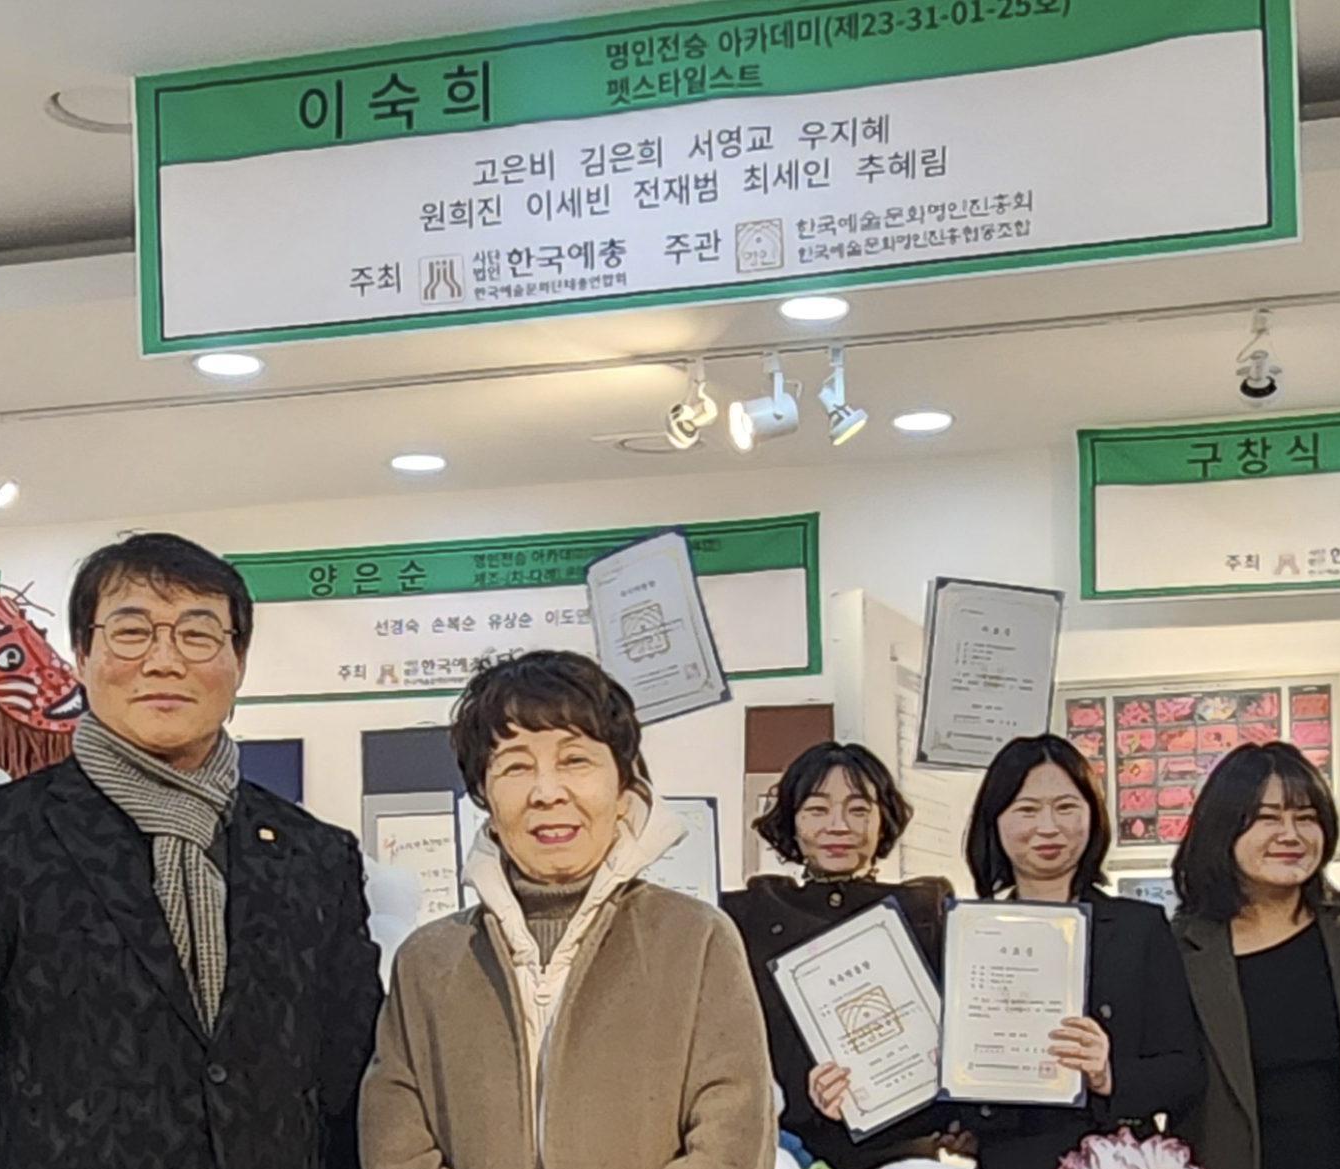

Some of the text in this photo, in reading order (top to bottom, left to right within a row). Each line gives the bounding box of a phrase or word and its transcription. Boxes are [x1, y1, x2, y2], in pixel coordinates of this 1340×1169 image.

[606, 33, 708, 71] 명인전승
[299, 60, 490, 139] 이숙희
[606, 64, 763, 107] 펫스타일스트
[472, 114, 890, 186] 고은비 김은희 서영교 우지혜
[420, 145, 948, 232] 원희진 이세빈 전재범 최세인 추혜림
[507, 238, 628, 279] 한국예총
[664, 229, 722, 266] 주관
[349, 262, 402, 297] 주최
[1187, 431, 1321, 476] 구창식
[308, 559, 428, 597] 양은순
